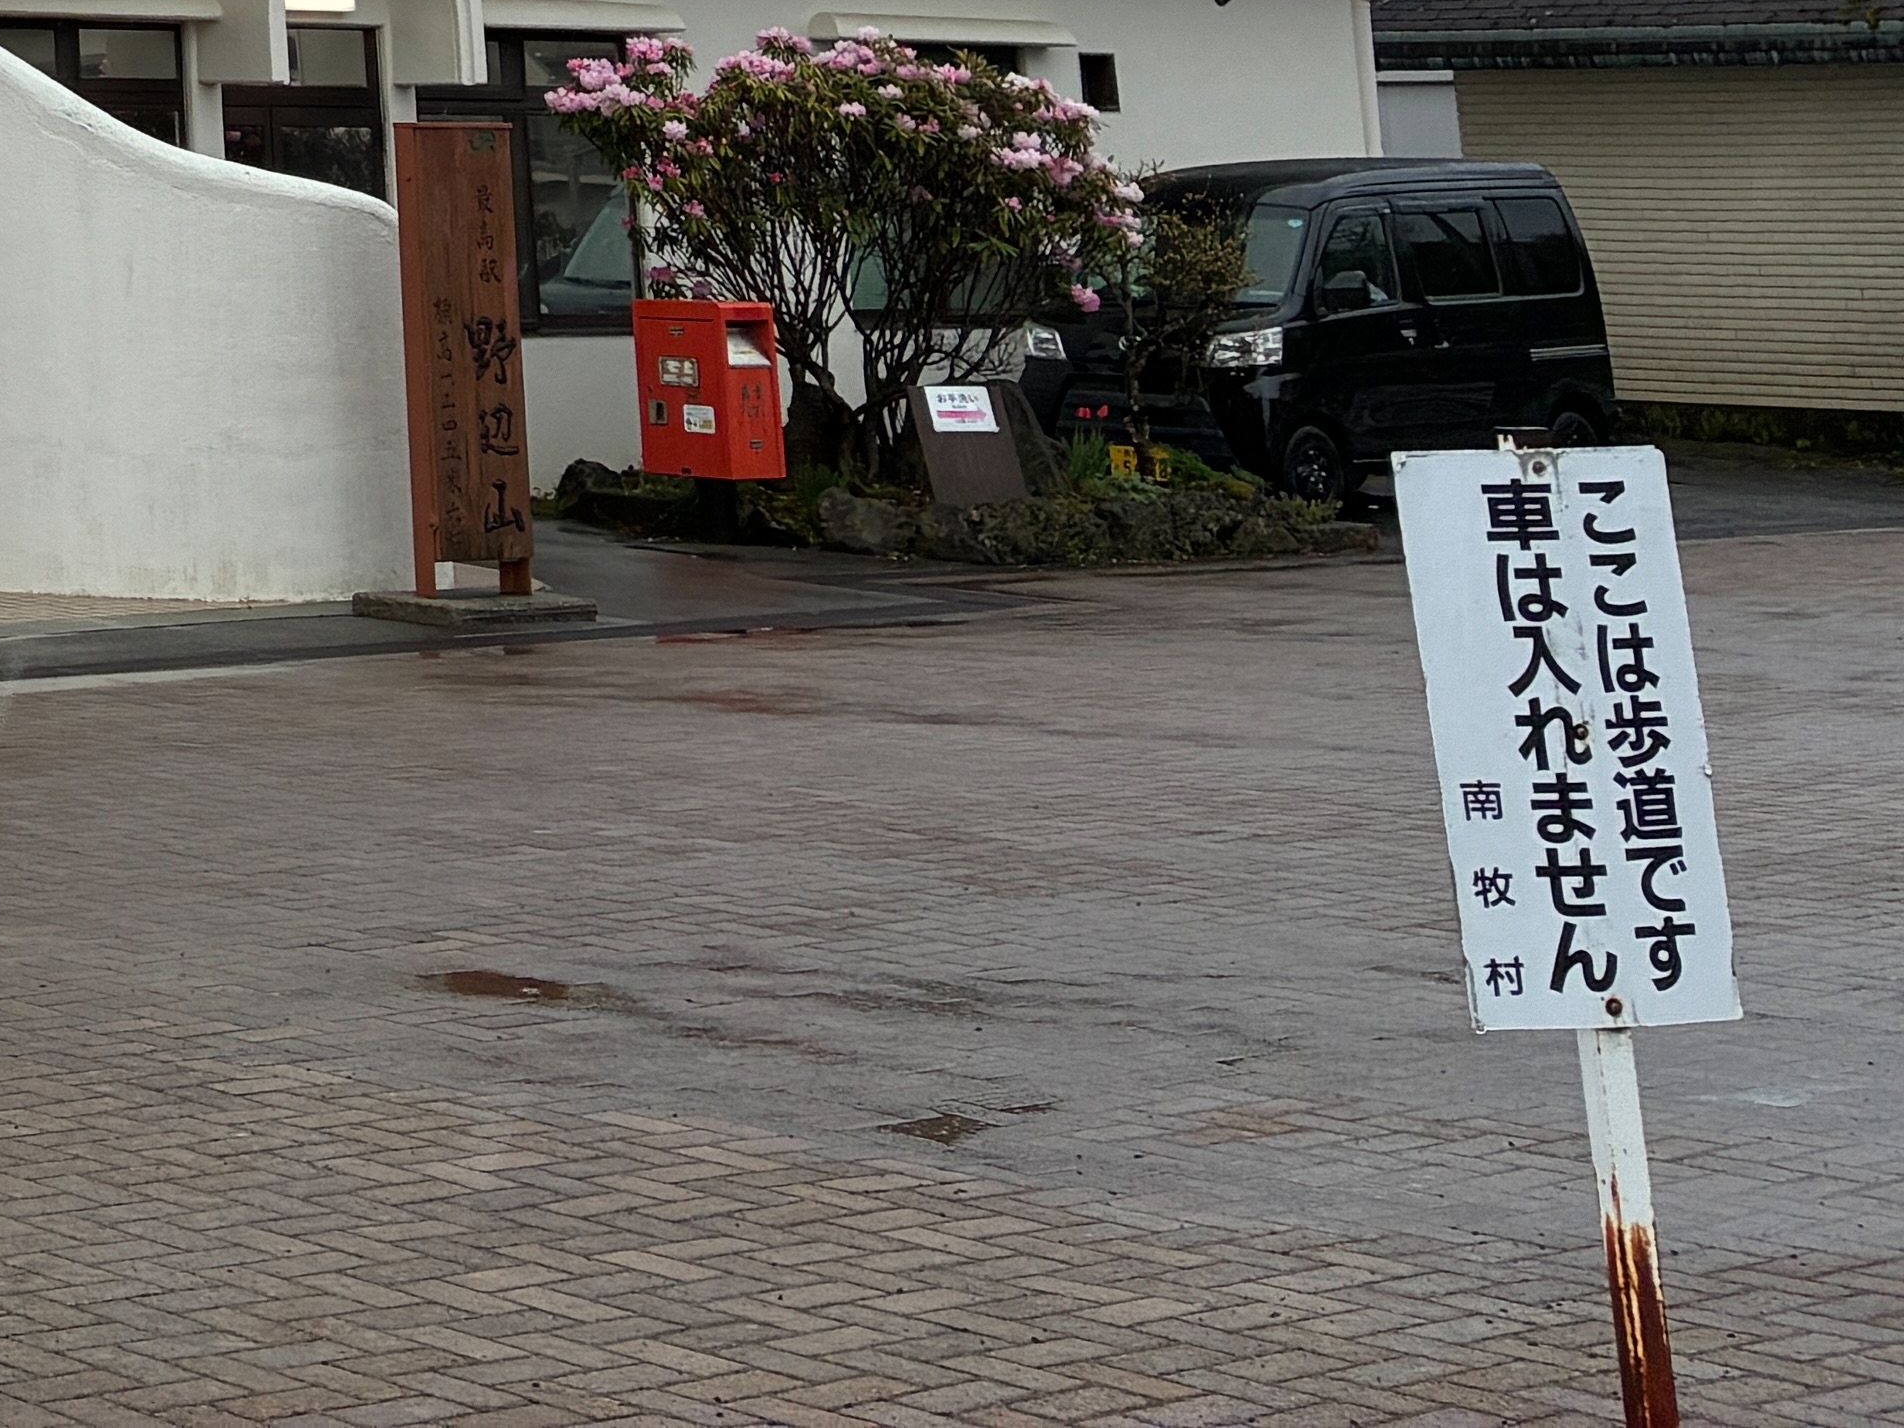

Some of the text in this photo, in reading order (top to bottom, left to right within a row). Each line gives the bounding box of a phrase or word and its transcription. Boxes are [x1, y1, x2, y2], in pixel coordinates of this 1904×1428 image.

[1459, 780, 1524, 997] 南牧村
[1481, 478, 1618, 994] 車は入れません
[1578, 479, 1696, 991] ここは歩道です
